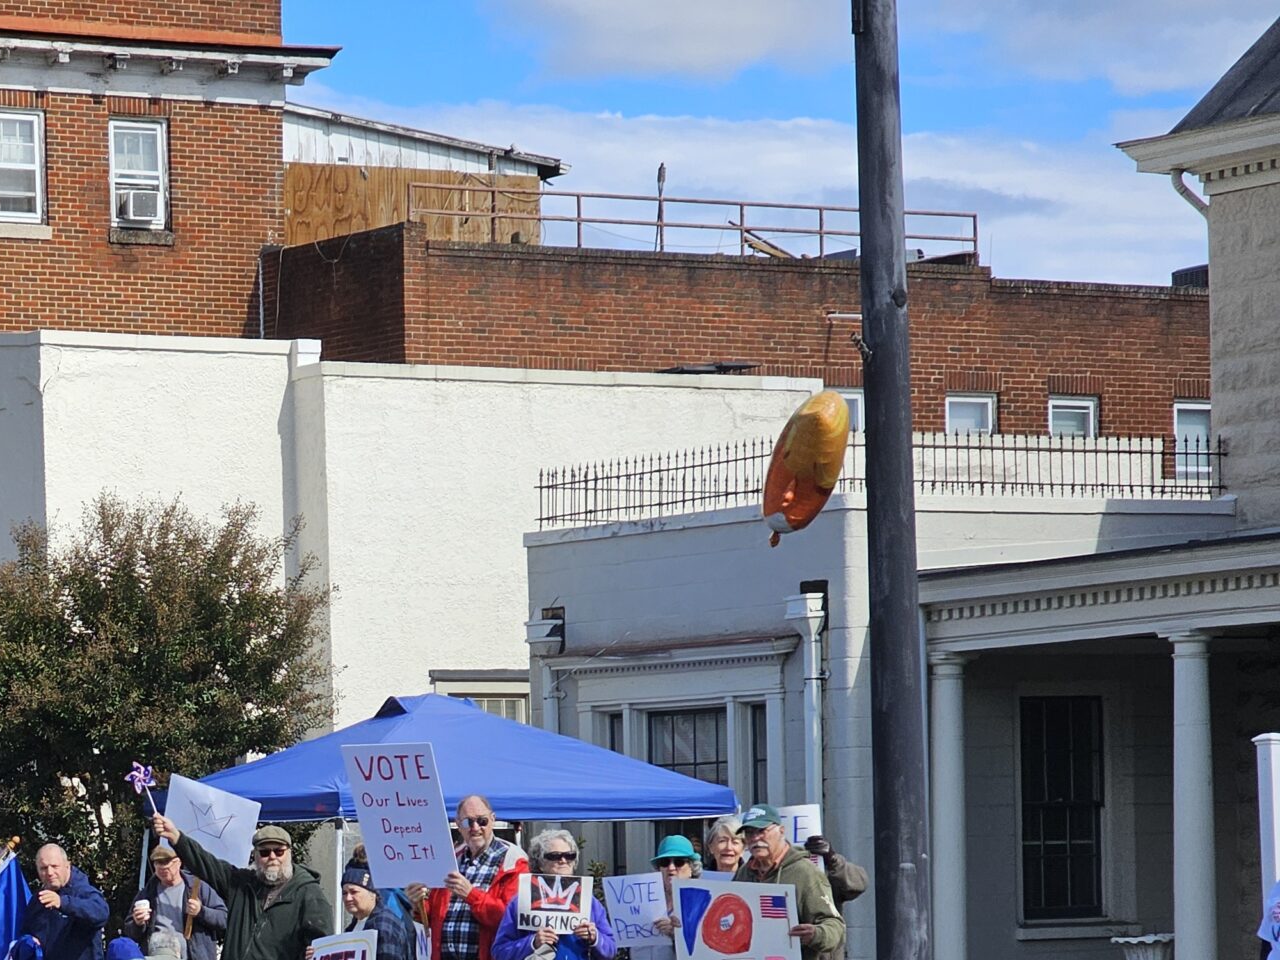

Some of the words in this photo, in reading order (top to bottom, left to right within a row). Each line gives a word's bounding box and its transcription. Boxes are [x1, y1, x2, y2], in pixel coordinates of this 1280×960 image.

[354, 755, 430, 781] VOTE
[362, 792, 390, 807] Our
[395, 791, 429, 807] Lives
[381, 818, 422, 838] Depend
[384, 845, 404, 861] On
[408, 844, 435, 860] It!
[608, 878, 659, 904] VOTE
[630, 905, 640, 915] IN
[520, 913, 542, 928] NO
[614, 918, 663, 940] PERSO
